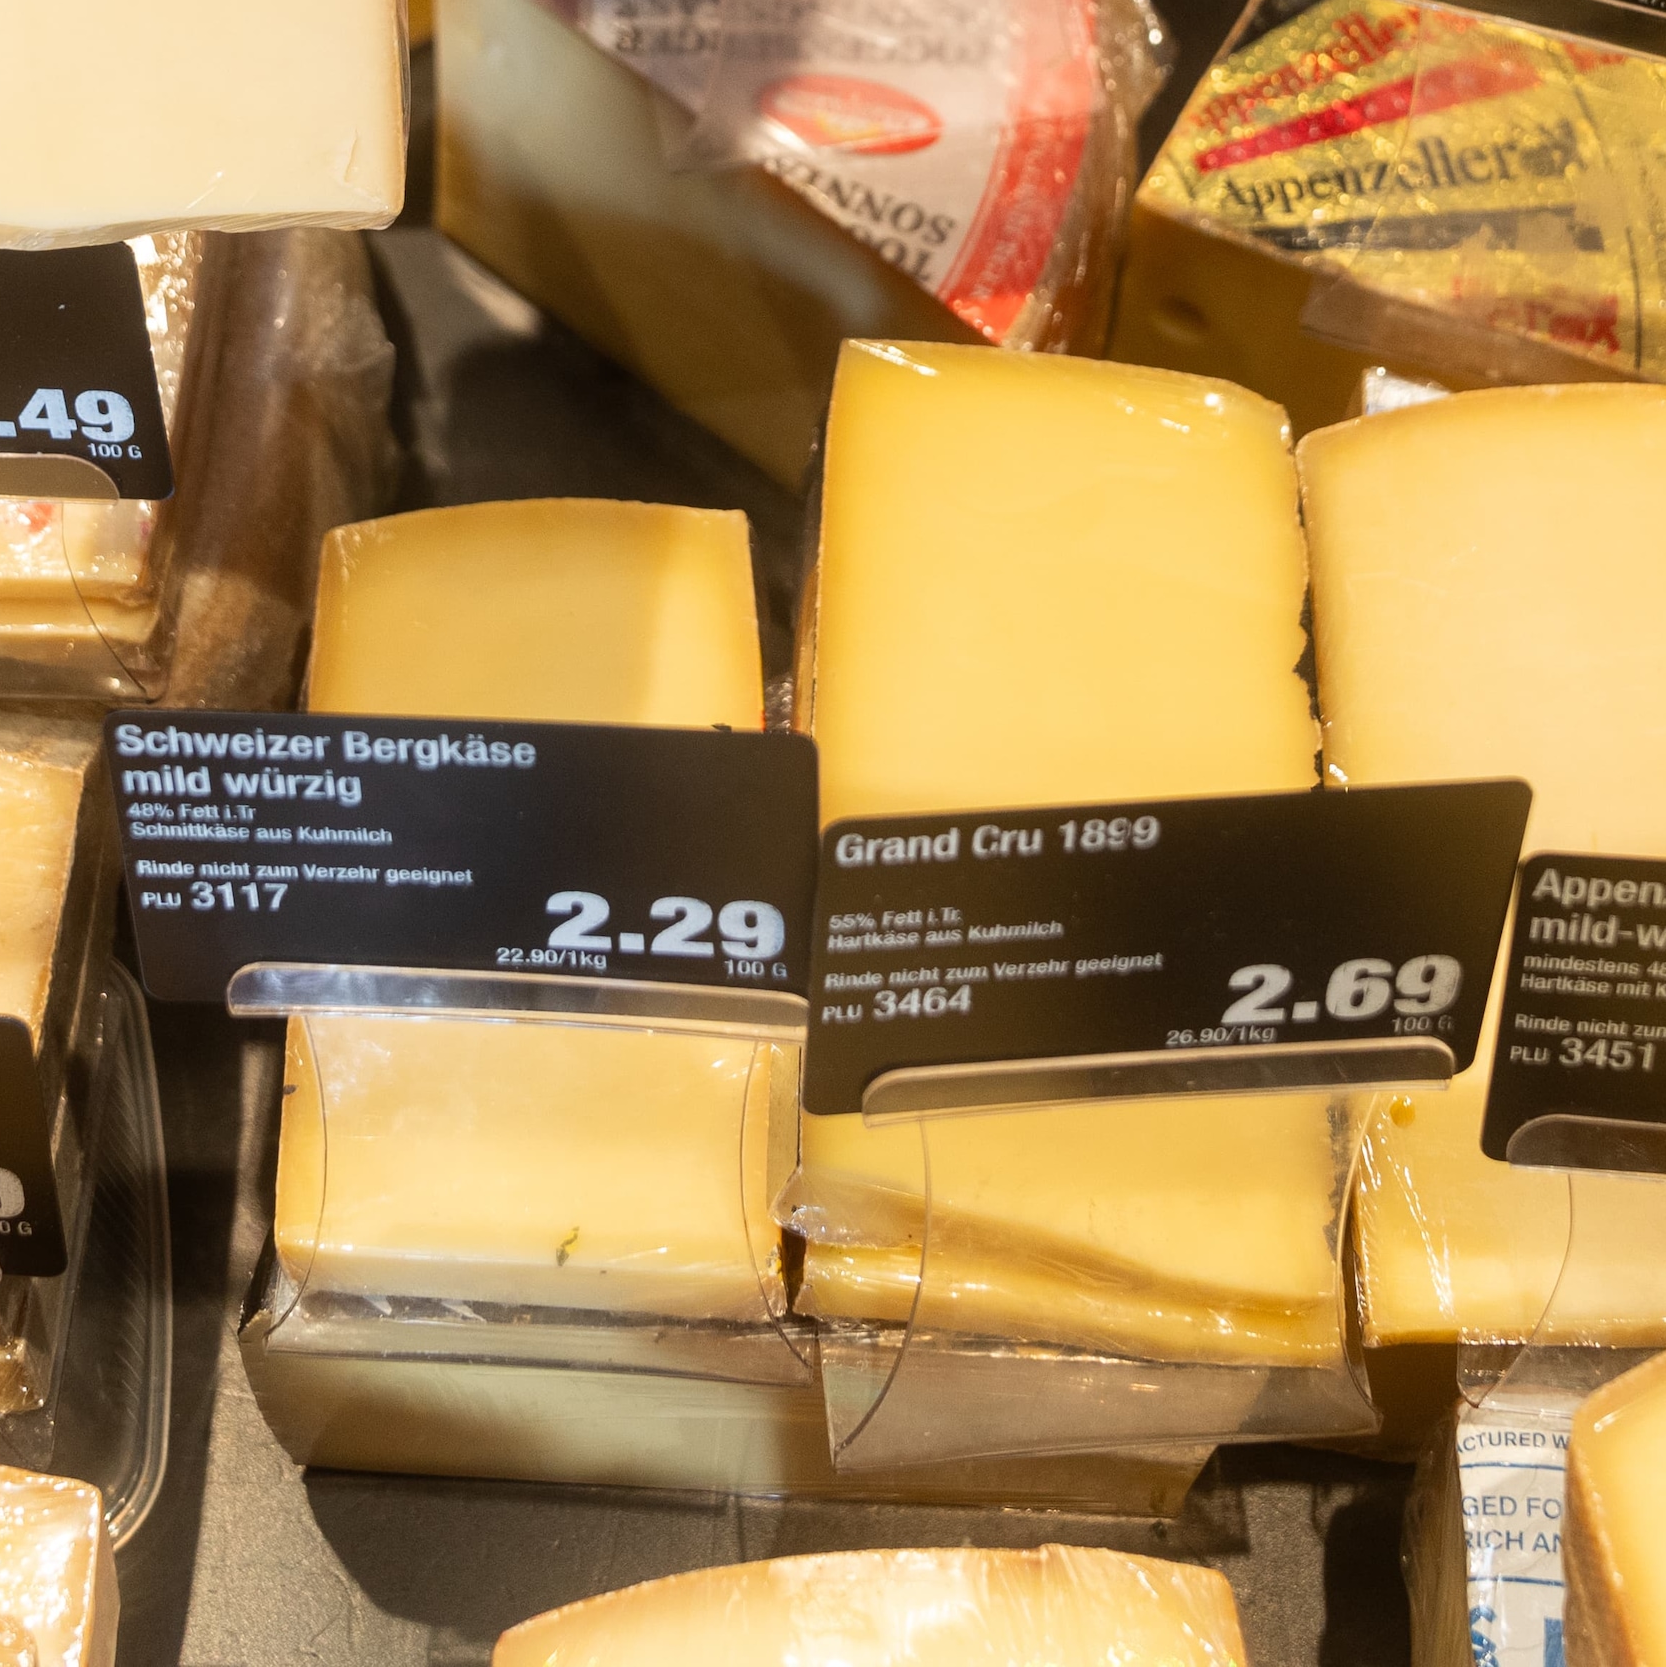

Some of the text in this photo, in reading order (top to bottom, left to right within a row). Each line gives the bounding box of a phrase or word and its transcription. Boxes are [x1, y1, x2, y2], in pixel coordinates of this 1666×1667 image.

[87, 443, 122, 458] 100
[127, 444, 143, 459] G
[115, 723, 537, 770] Schweizer Bergkäse
[122, 765, 362, 807] mild würzig
[178, 804, 221, 820] Fett
[130, 821, 393, 846] Schnittkäse aus Kuhmilch
[835, 815, 1160, 866] Grand Cru 1899
[136, 859, 474, 887] Rinde nicht zum Verzehr geeignet
[141, 881, 288, 912] PLU 3117
[546, 890, 785, 960] 2.29
[967, 920, 1064, 941] Kuhmilch
[496, 947, 607, 970] 22.90/1kg
[1523, 954, 1639, 976] mindestens
[822, 984, 972, 1023] PLU 3464
[1221, 954, 1462, 1025] 2.69
[1165, 1023, 1276, 1047] 26.90/1kg
[1510, 1038, 1656, 1071] PLU 3451
[1462, 1495, 1562, 1519] GED FO
